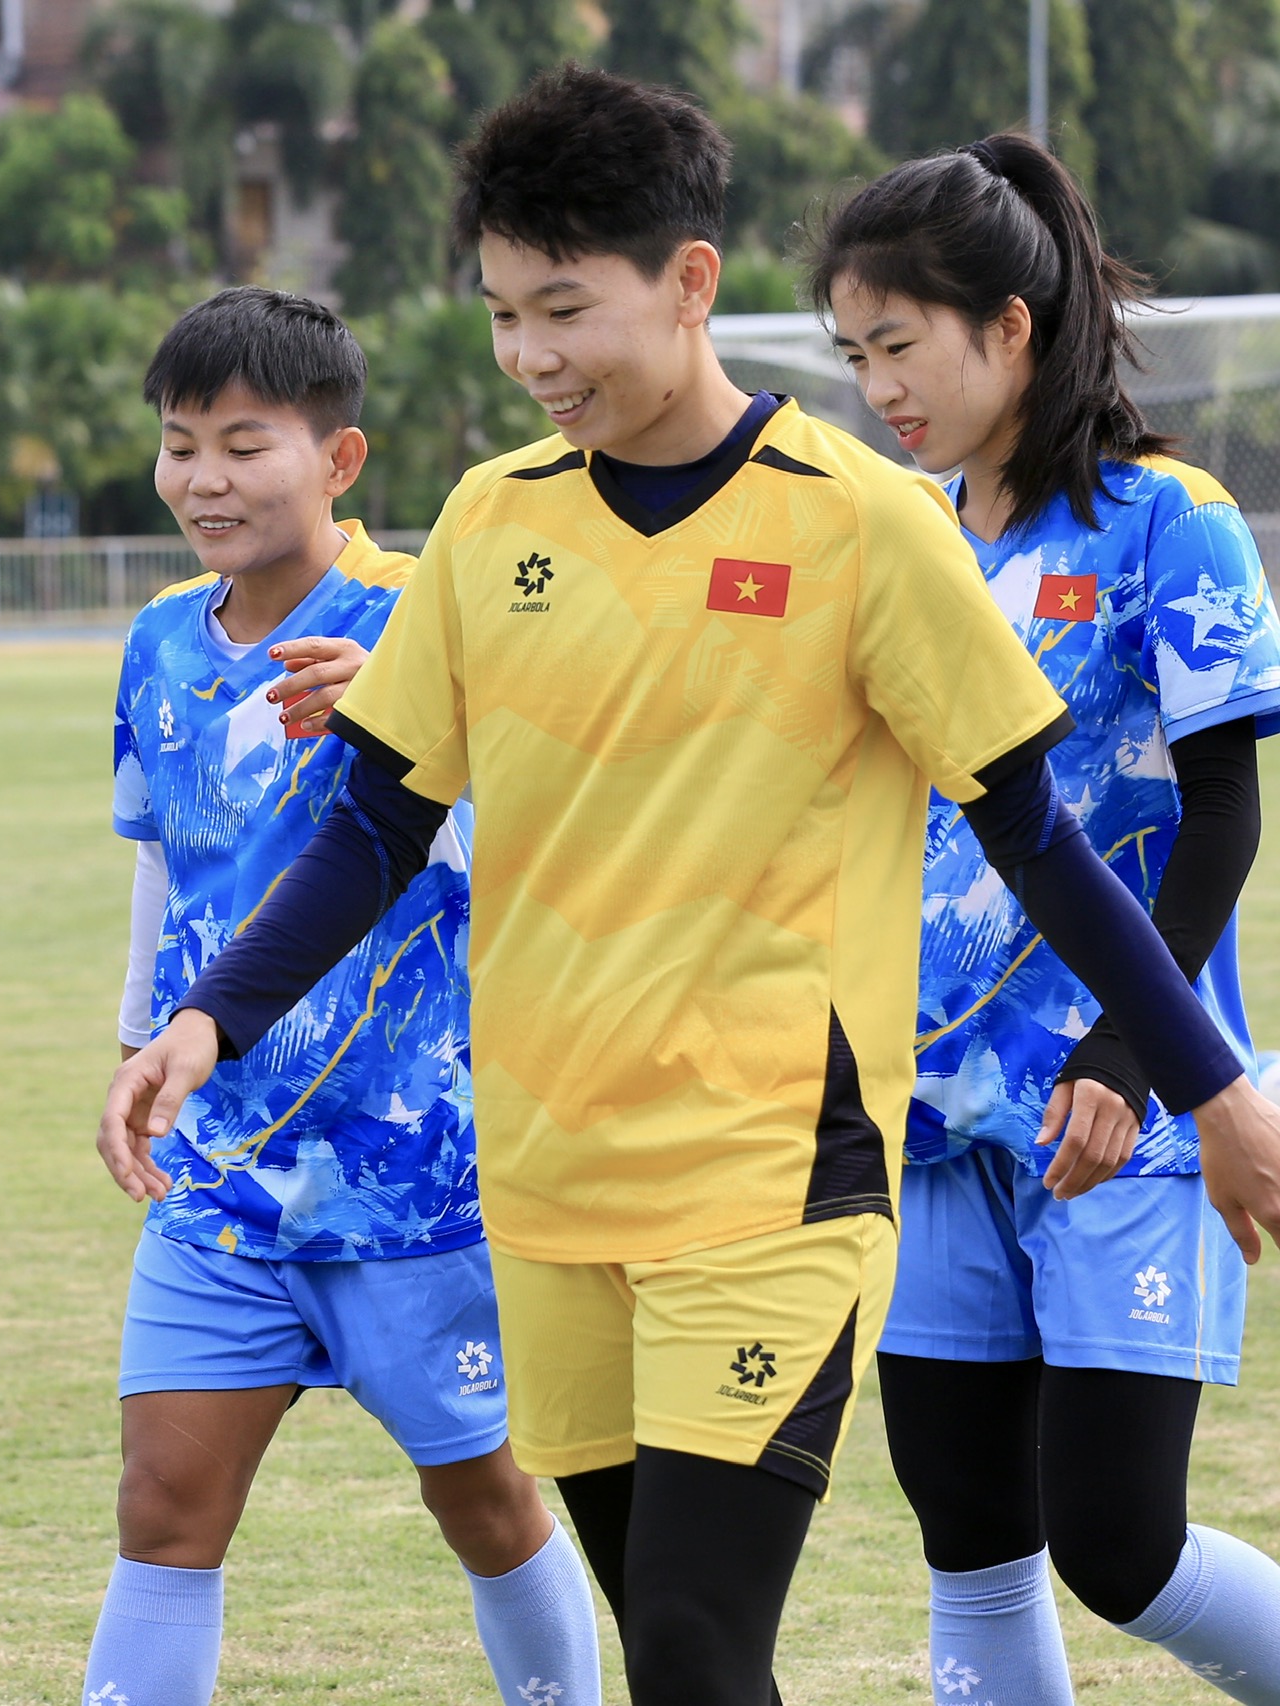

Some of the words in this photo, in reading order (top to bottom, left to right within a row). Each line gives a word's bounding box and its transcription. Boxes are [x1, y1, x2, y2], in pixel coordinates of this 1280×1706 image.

[508, 601, 550, 613] JOGARBOLA
[1127, 1309, 1170, 1325] JOGARBOLA
[458, 1378, 498, 1396] JOGARBOLA
